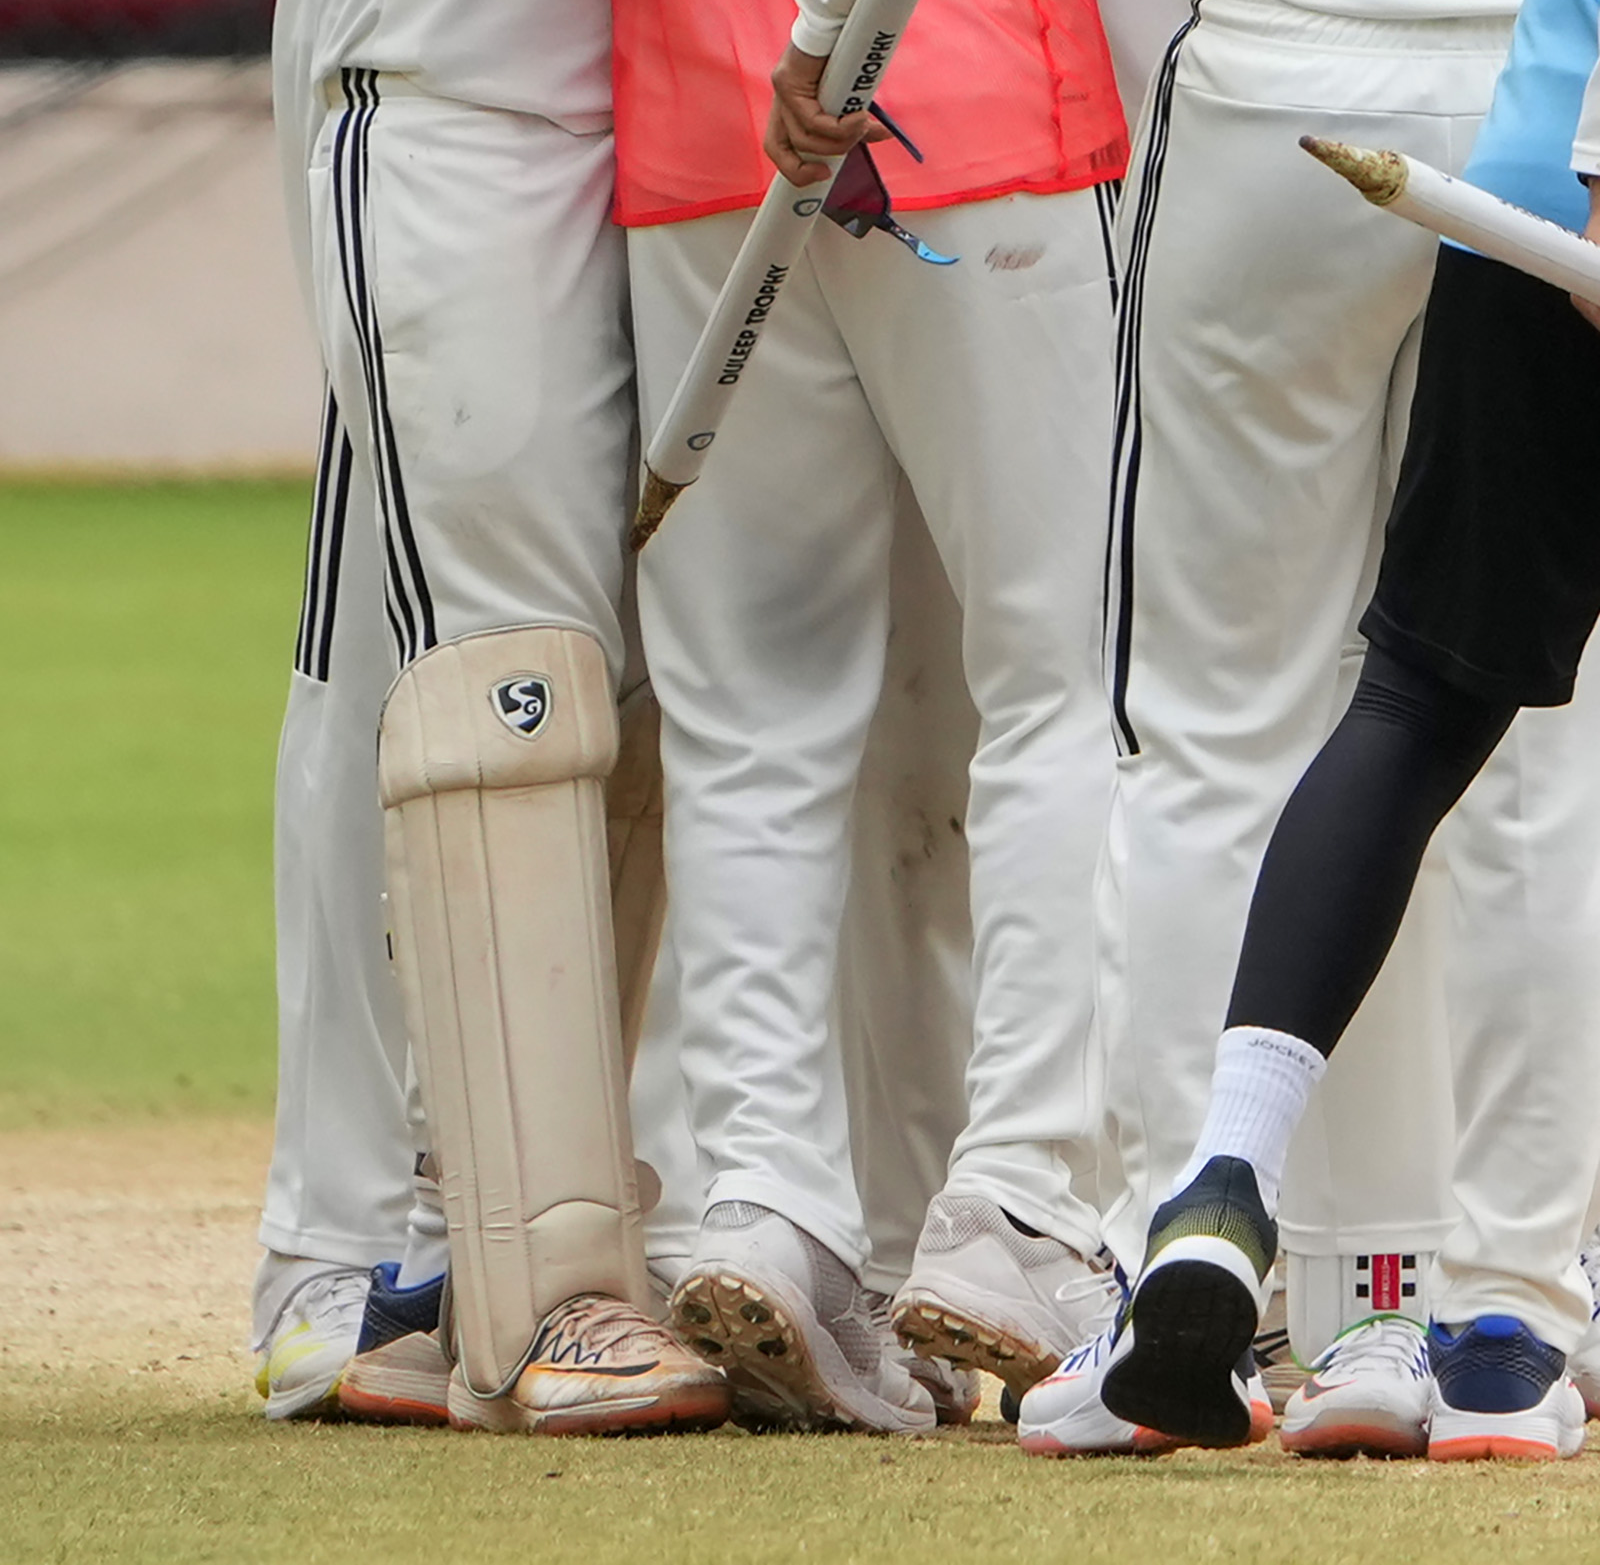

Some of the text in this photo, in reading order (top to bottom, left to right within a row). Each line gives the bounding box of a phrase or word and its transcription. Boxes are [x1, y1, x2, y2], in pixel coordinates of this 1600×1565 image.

[851, 30, 896, 92] TROPHY
[717, 263, 790, 385] DULEEP TROPHY
[1247, 1038, 1316, 1072] JOCKEY
